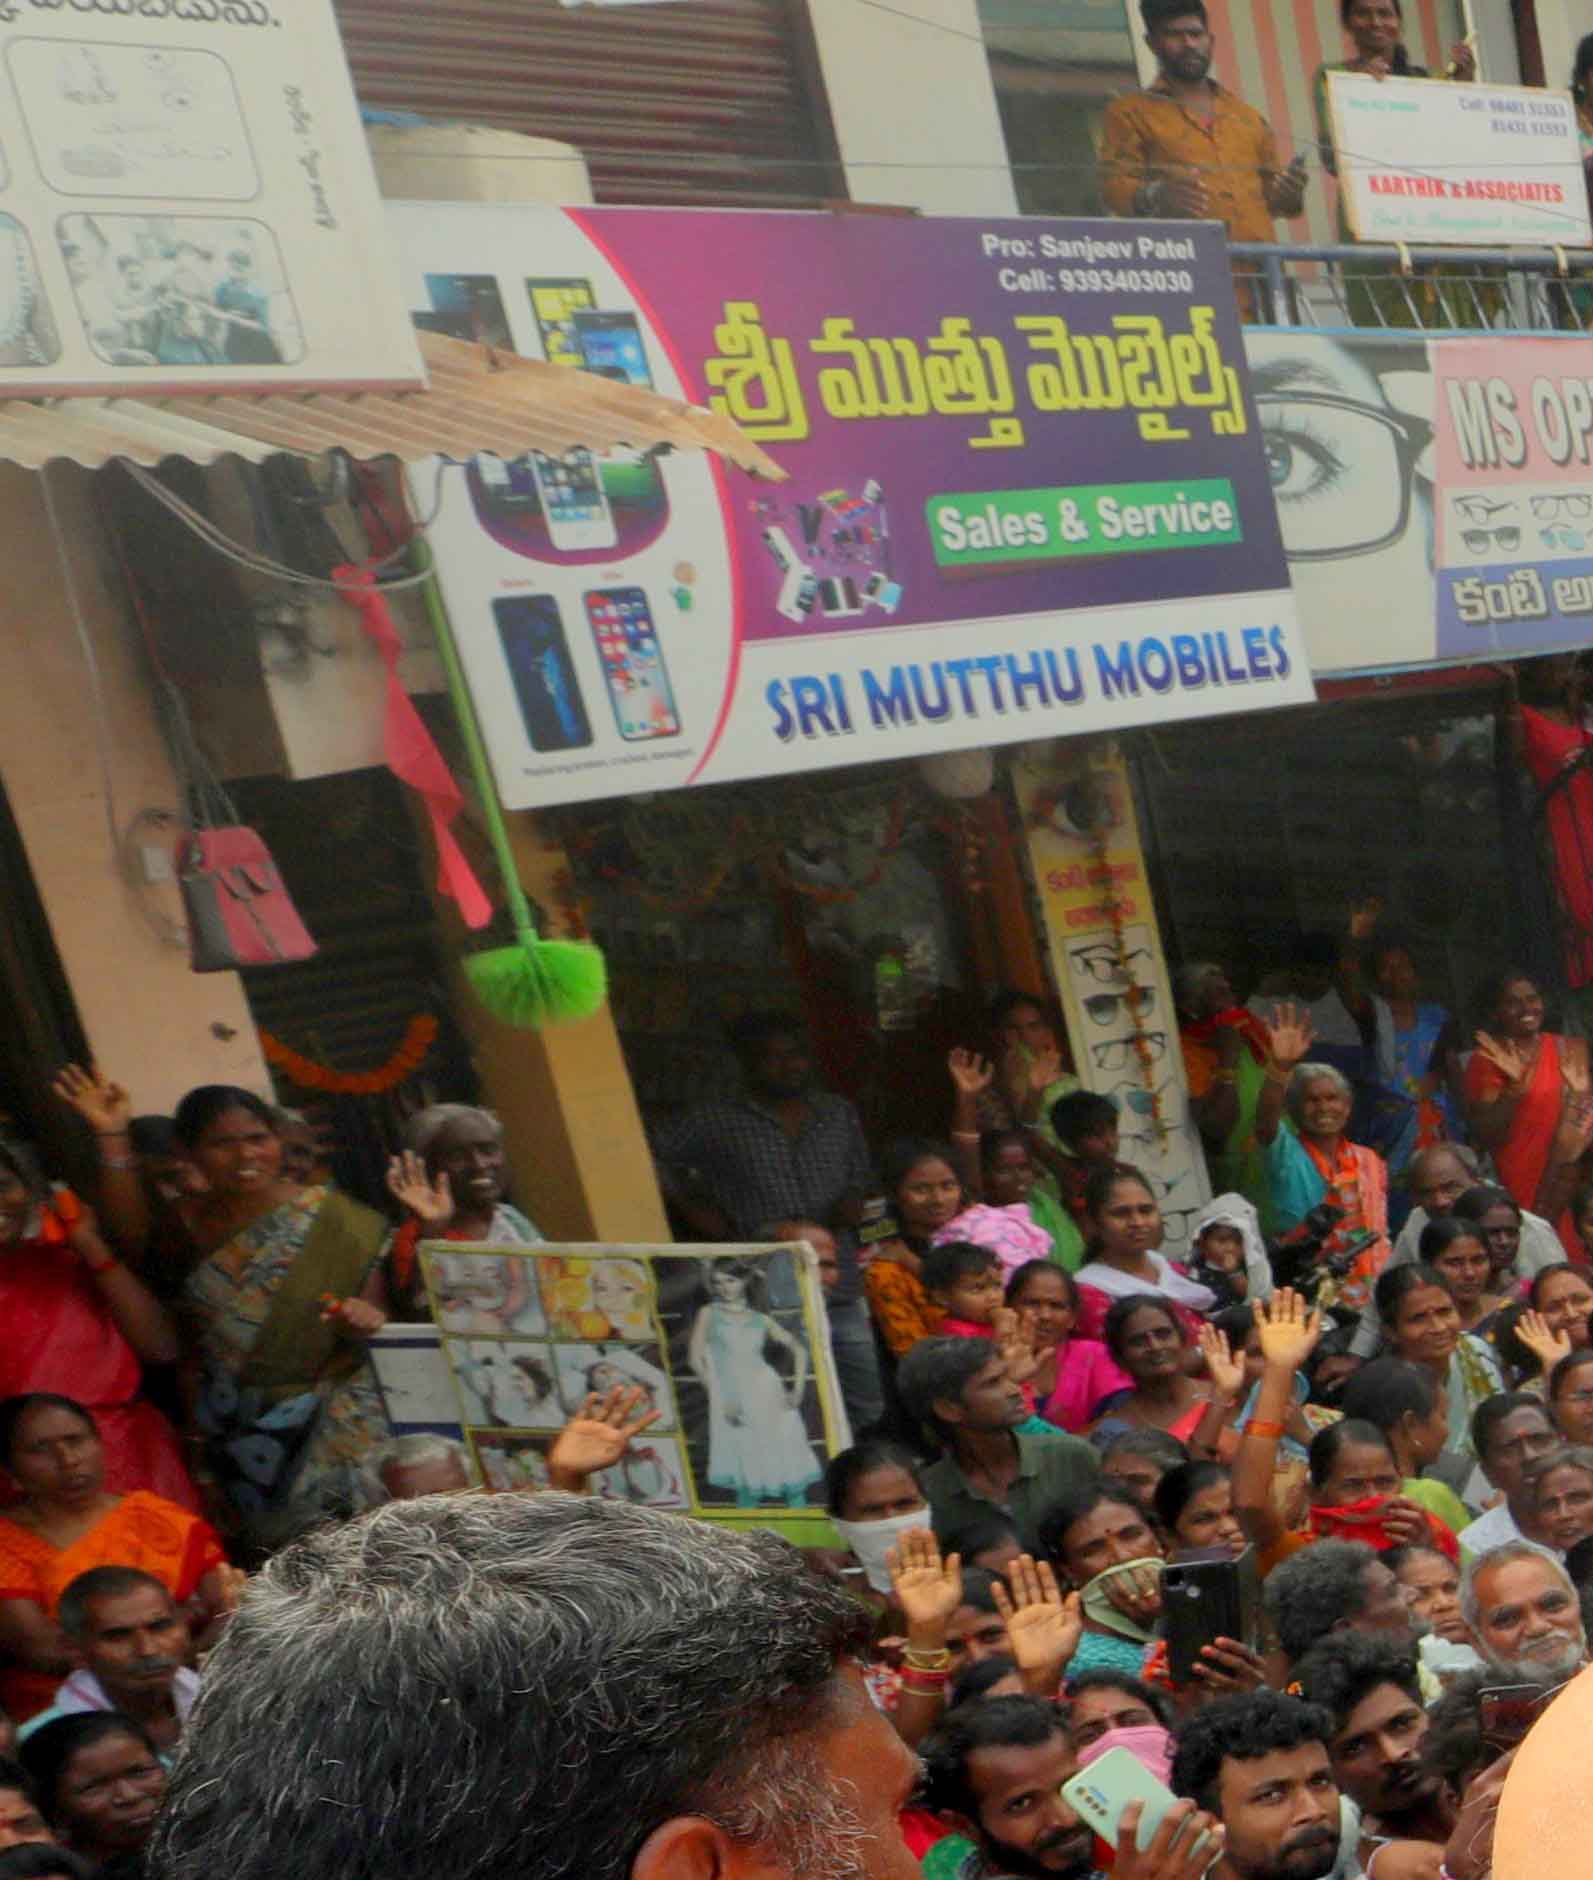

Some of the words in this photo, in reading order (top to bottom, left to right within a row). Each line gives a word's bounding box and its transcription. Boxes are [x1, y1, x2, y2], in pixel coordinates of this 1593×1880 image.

[1368, 174, 1446, 199] KARTHIK
[1464, 179, 1565, 204] ASSOCIATES
[981, 233, 1035, 258] Pro:
[1039, 234, 1133, 264] Sanjeev
[1136, 236, 1196, 261] Patel
[998, 268, 1056, 292] Cell:
[1058, 269, 1194, 293] 9393403030
[703, 301, 809, 442] శ్రీ
[809, 316, 1025, 448] ముత్తు
[1014, 305, 1247, 440] మొబైల్స్
[1443, 376, 1528, 470] MS
[937, 505, 1048, 553] Sales
[1058, 498, 1089, 543] &
[1098, 492, 1233, 543] Service
[765, 671, 856, 742] SRI
[860, 645, 1087, 731] MUTTHU
[1092, 624, 1291, 701] MOBILES
